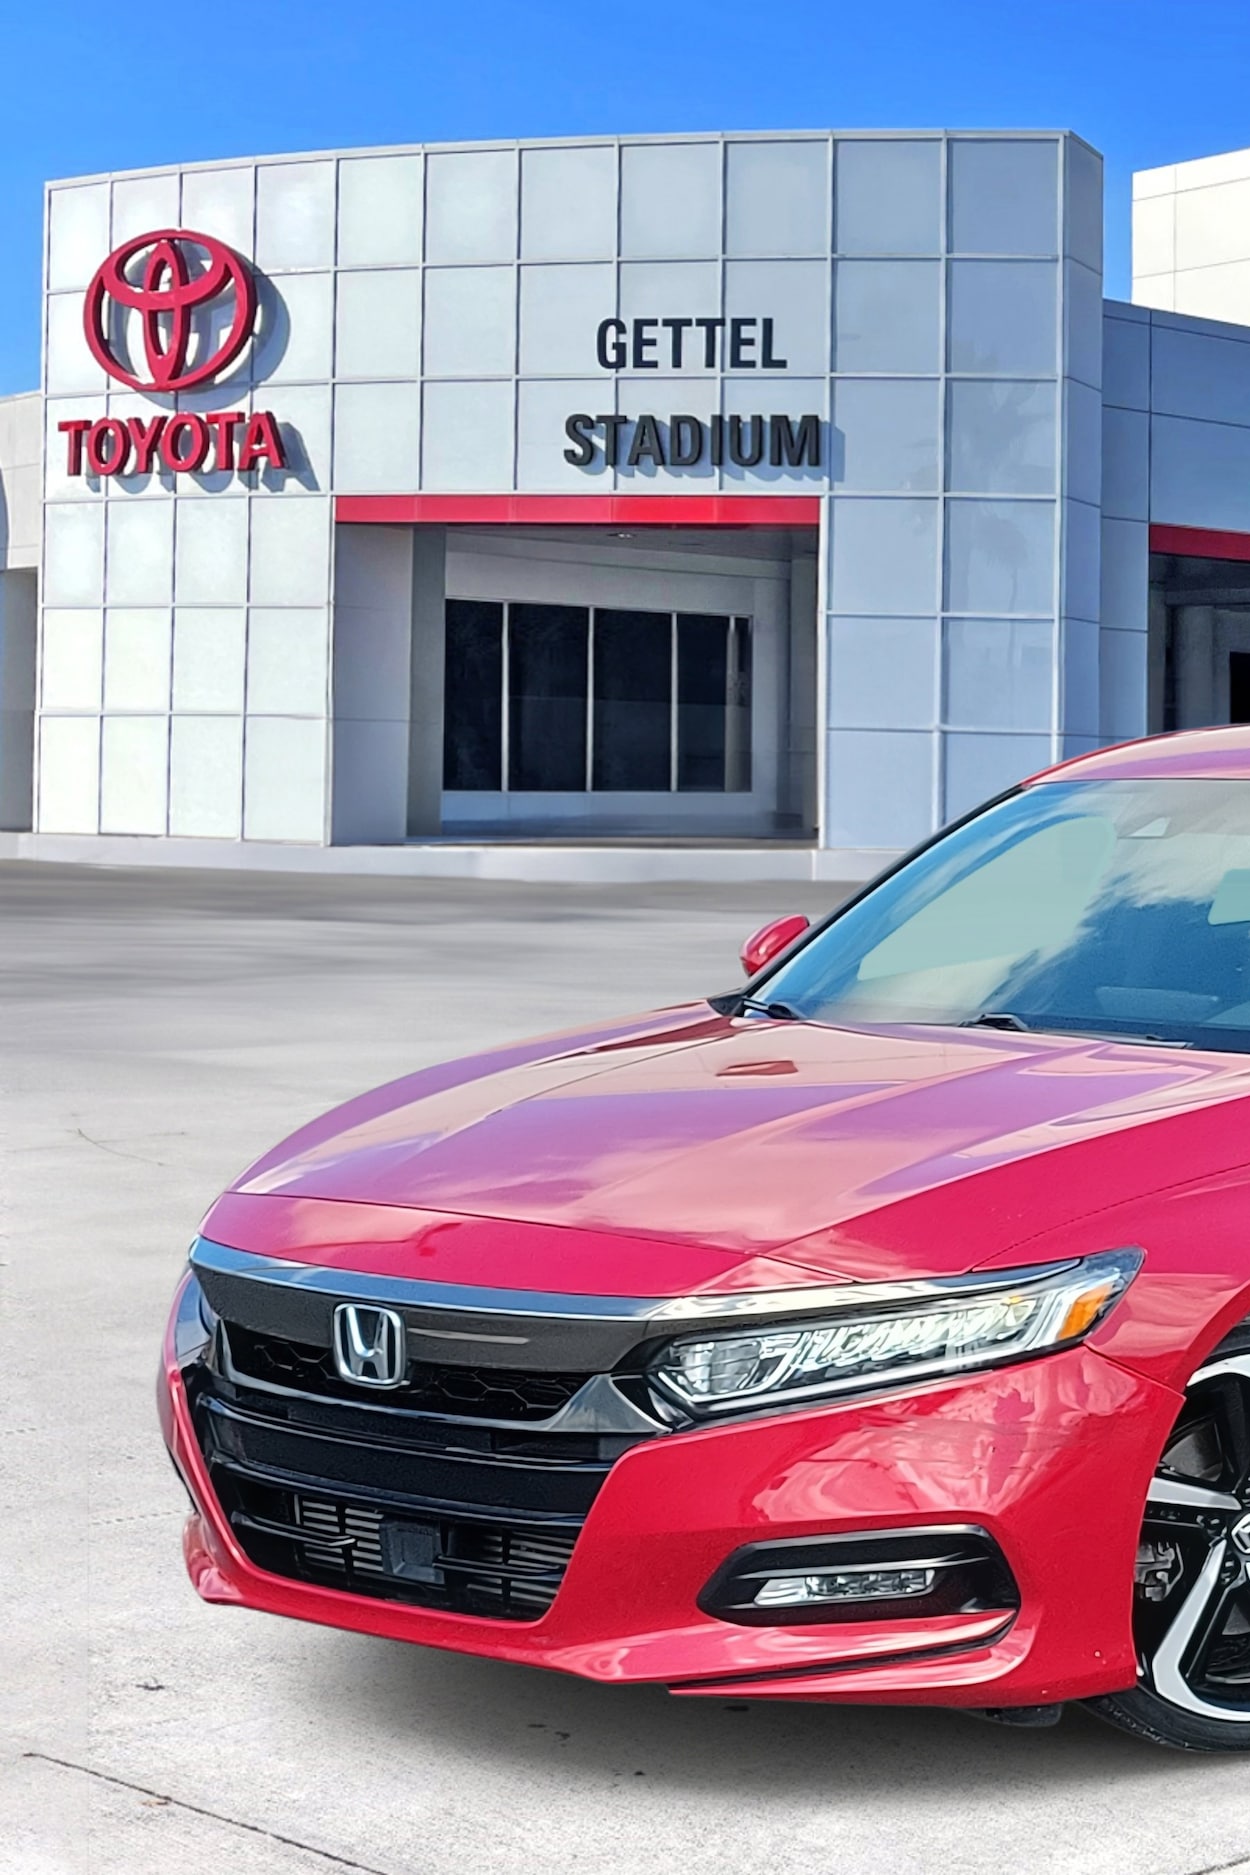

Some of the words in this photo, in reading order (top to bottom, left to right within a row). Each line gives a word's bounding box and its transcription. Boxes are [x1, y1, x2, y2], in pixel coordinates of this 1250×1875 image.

[597, 318, 788, 369] GETTEL
[58, 411, 286, 477] TOYOTA
[564, 413, 822, 467] STADIUM
